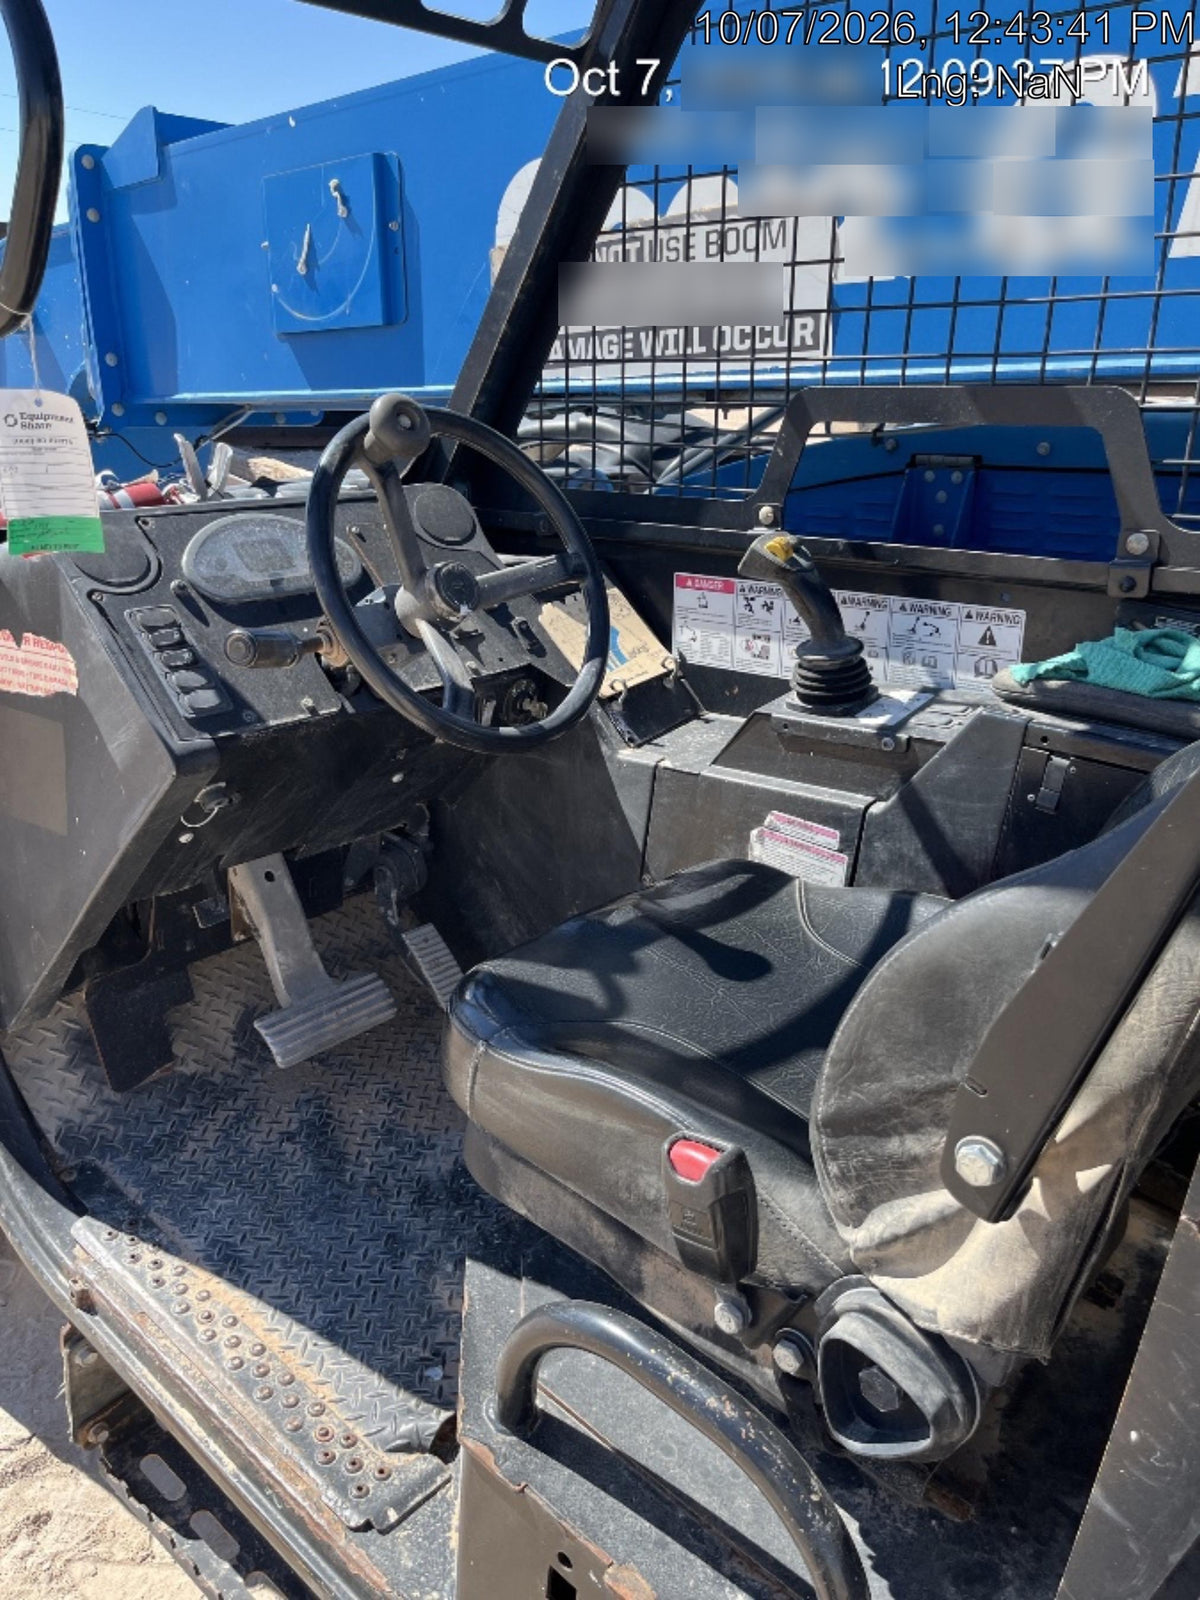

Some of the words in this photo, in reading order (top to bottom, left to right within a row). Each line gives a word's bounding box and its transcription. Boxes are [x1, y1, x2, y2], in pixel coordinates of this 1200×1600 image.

[648, 233, 696, 262] USE
[705, 219, 787, 258] BOOM
[547, 332, 634, 360] AMAGE
[639, 327, 707, 357] WILL
[712, 316, 815, 351] OCCUR
[909, 603, 952, 617] WARNING
[975, 610, 1022, 625] WARNING
